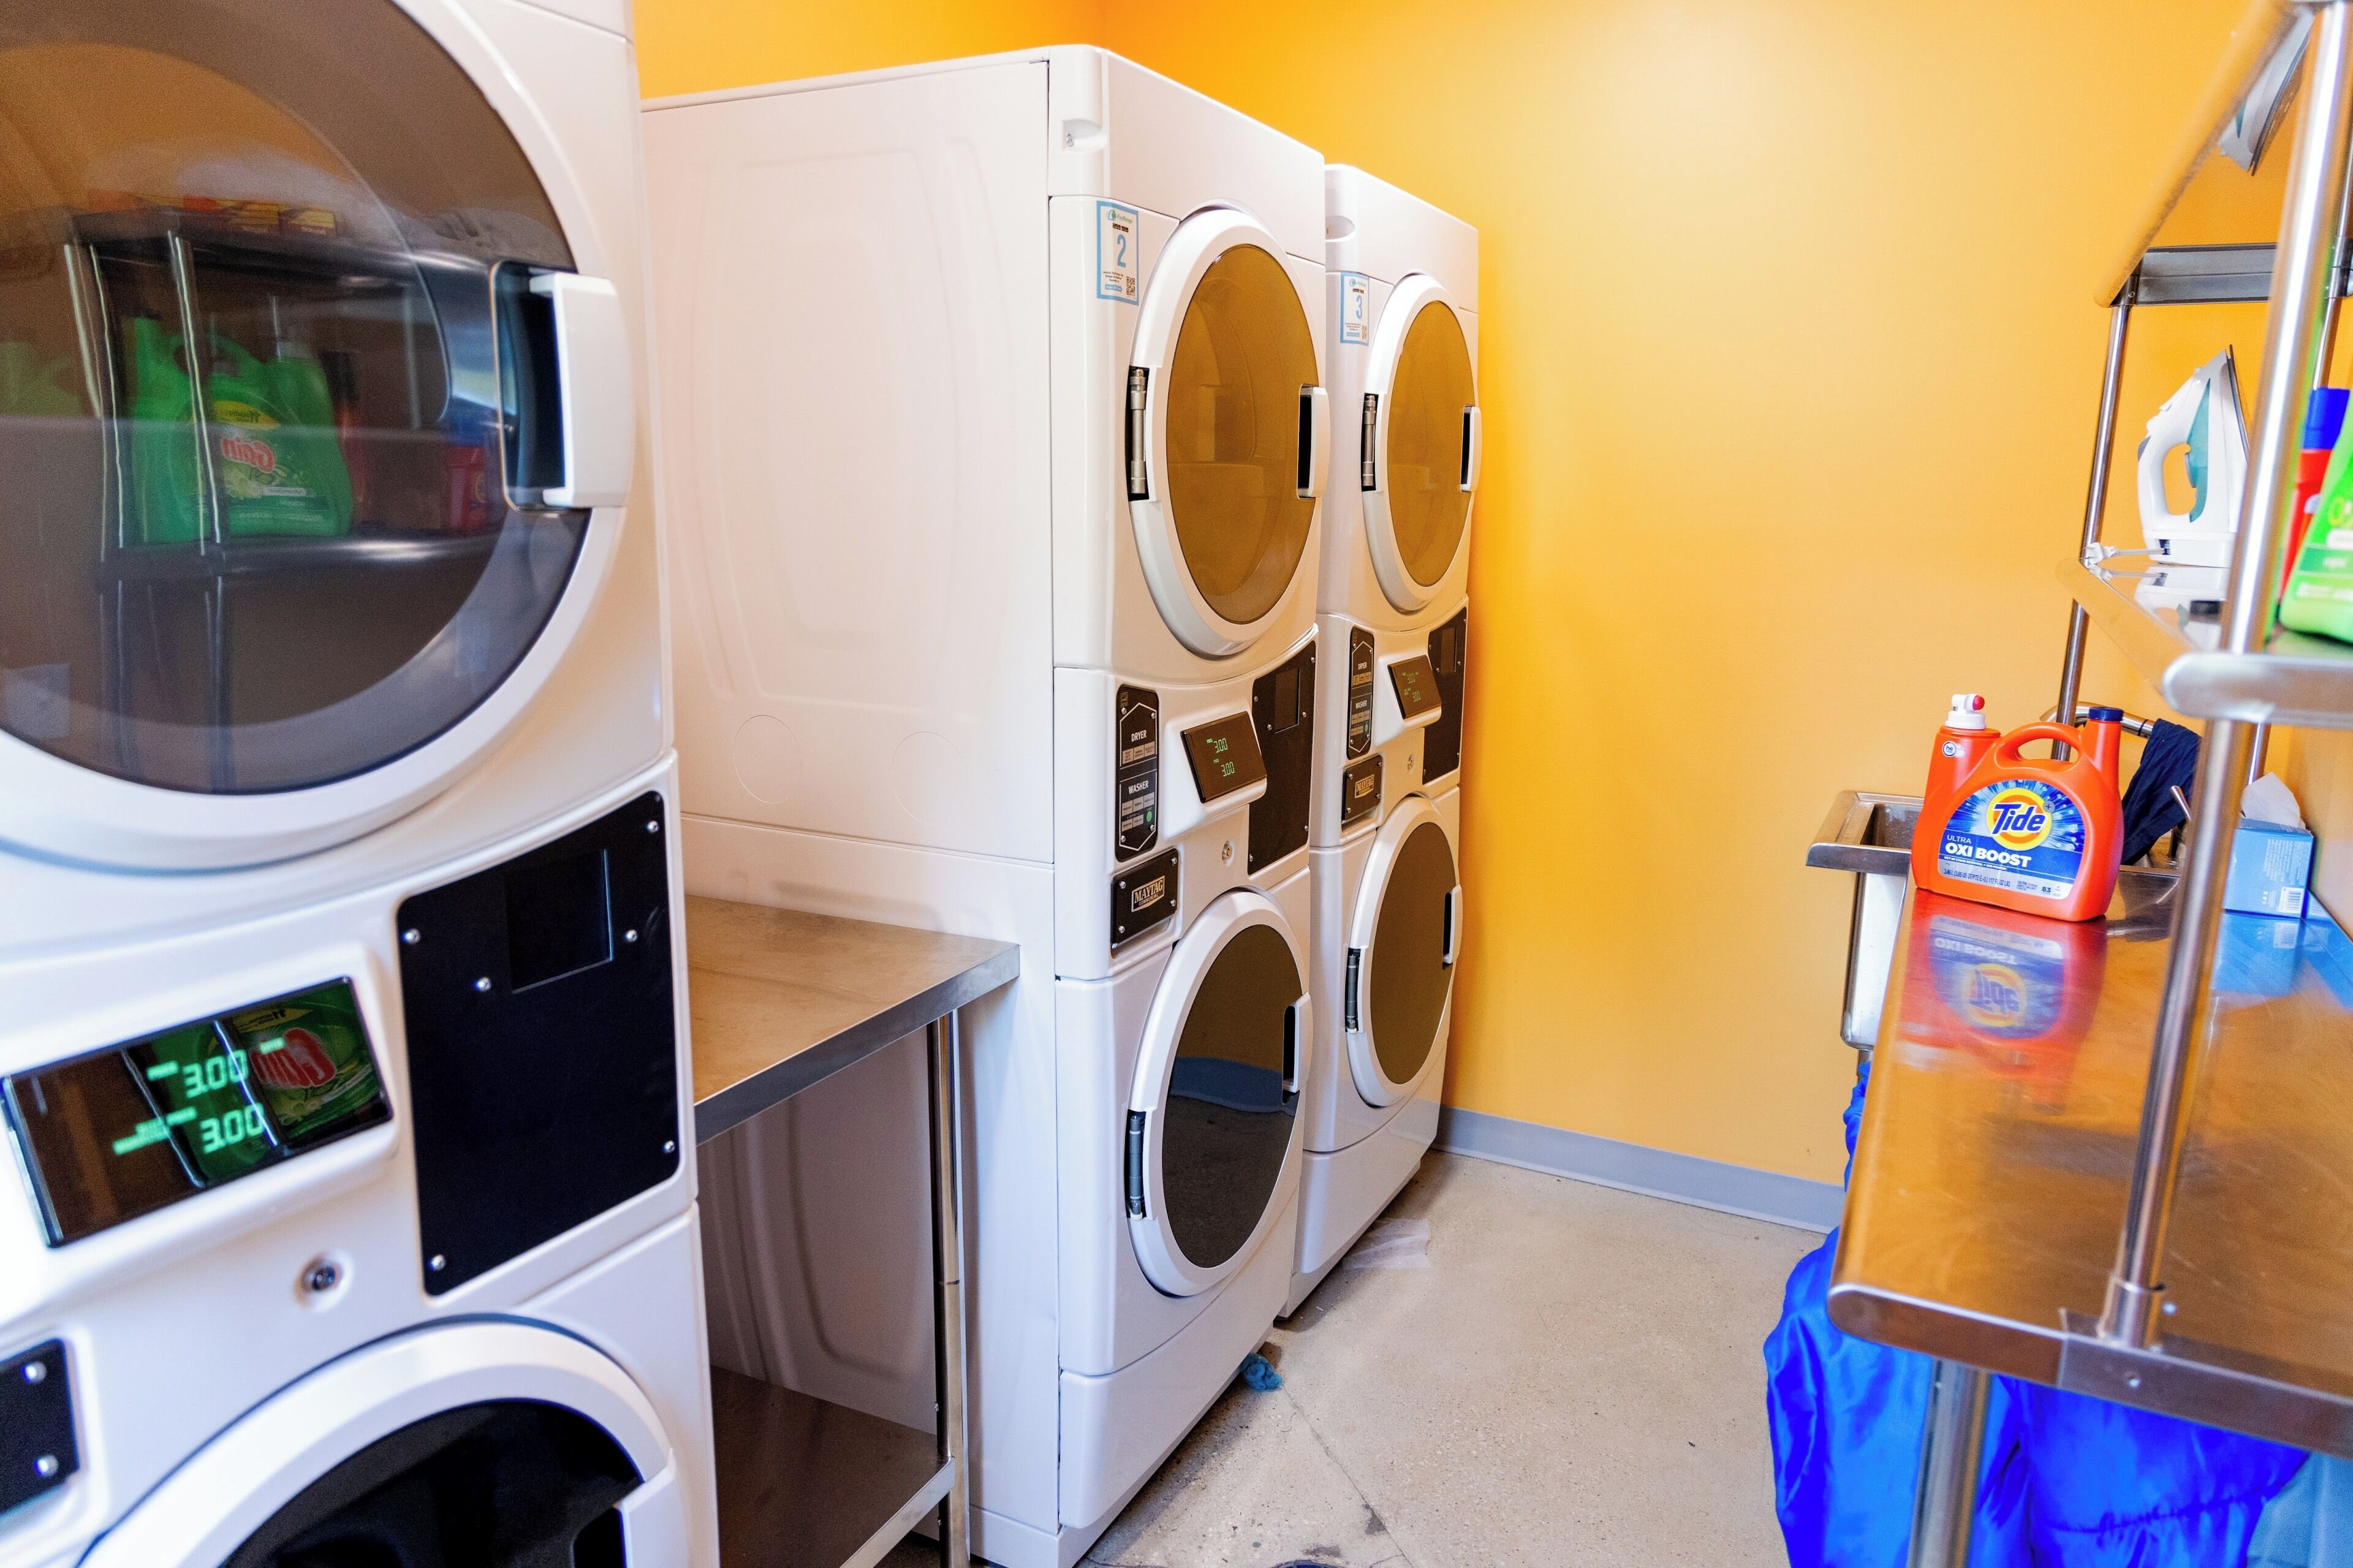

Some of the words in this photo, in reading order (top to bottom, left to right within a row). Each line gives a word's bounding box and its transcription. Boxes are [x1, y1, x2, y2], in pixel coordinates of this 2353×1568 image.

[1117, 234, 1126, 268] 2
[1355, 295, 1363, 320] 3
[1358, 662, 1367, 670] DRYER
[1355, 700, 1367, 710] WASHER
[1131, 730, 1147, 742] DRYER
[1214, 738, 1228, 753] 3.00
[1221, 761, 1235, 777] 3.00
[1128, 780, 1149, 795] WASHER
[1356, 776, 1373, 792] MAYTAG
[1992, 804, 2045, 835] Tide
[1947, 835, 1971, 844] ULTRA
[1945, 843, 1973, 858] OXI
[1975, 847, 2031, 868] BOOST
[1134, 879, 1163, 904] MAYTAG
[182, 1049, 249, 1099] 3.00
[199, 1102, 264, 1154] 3.00
